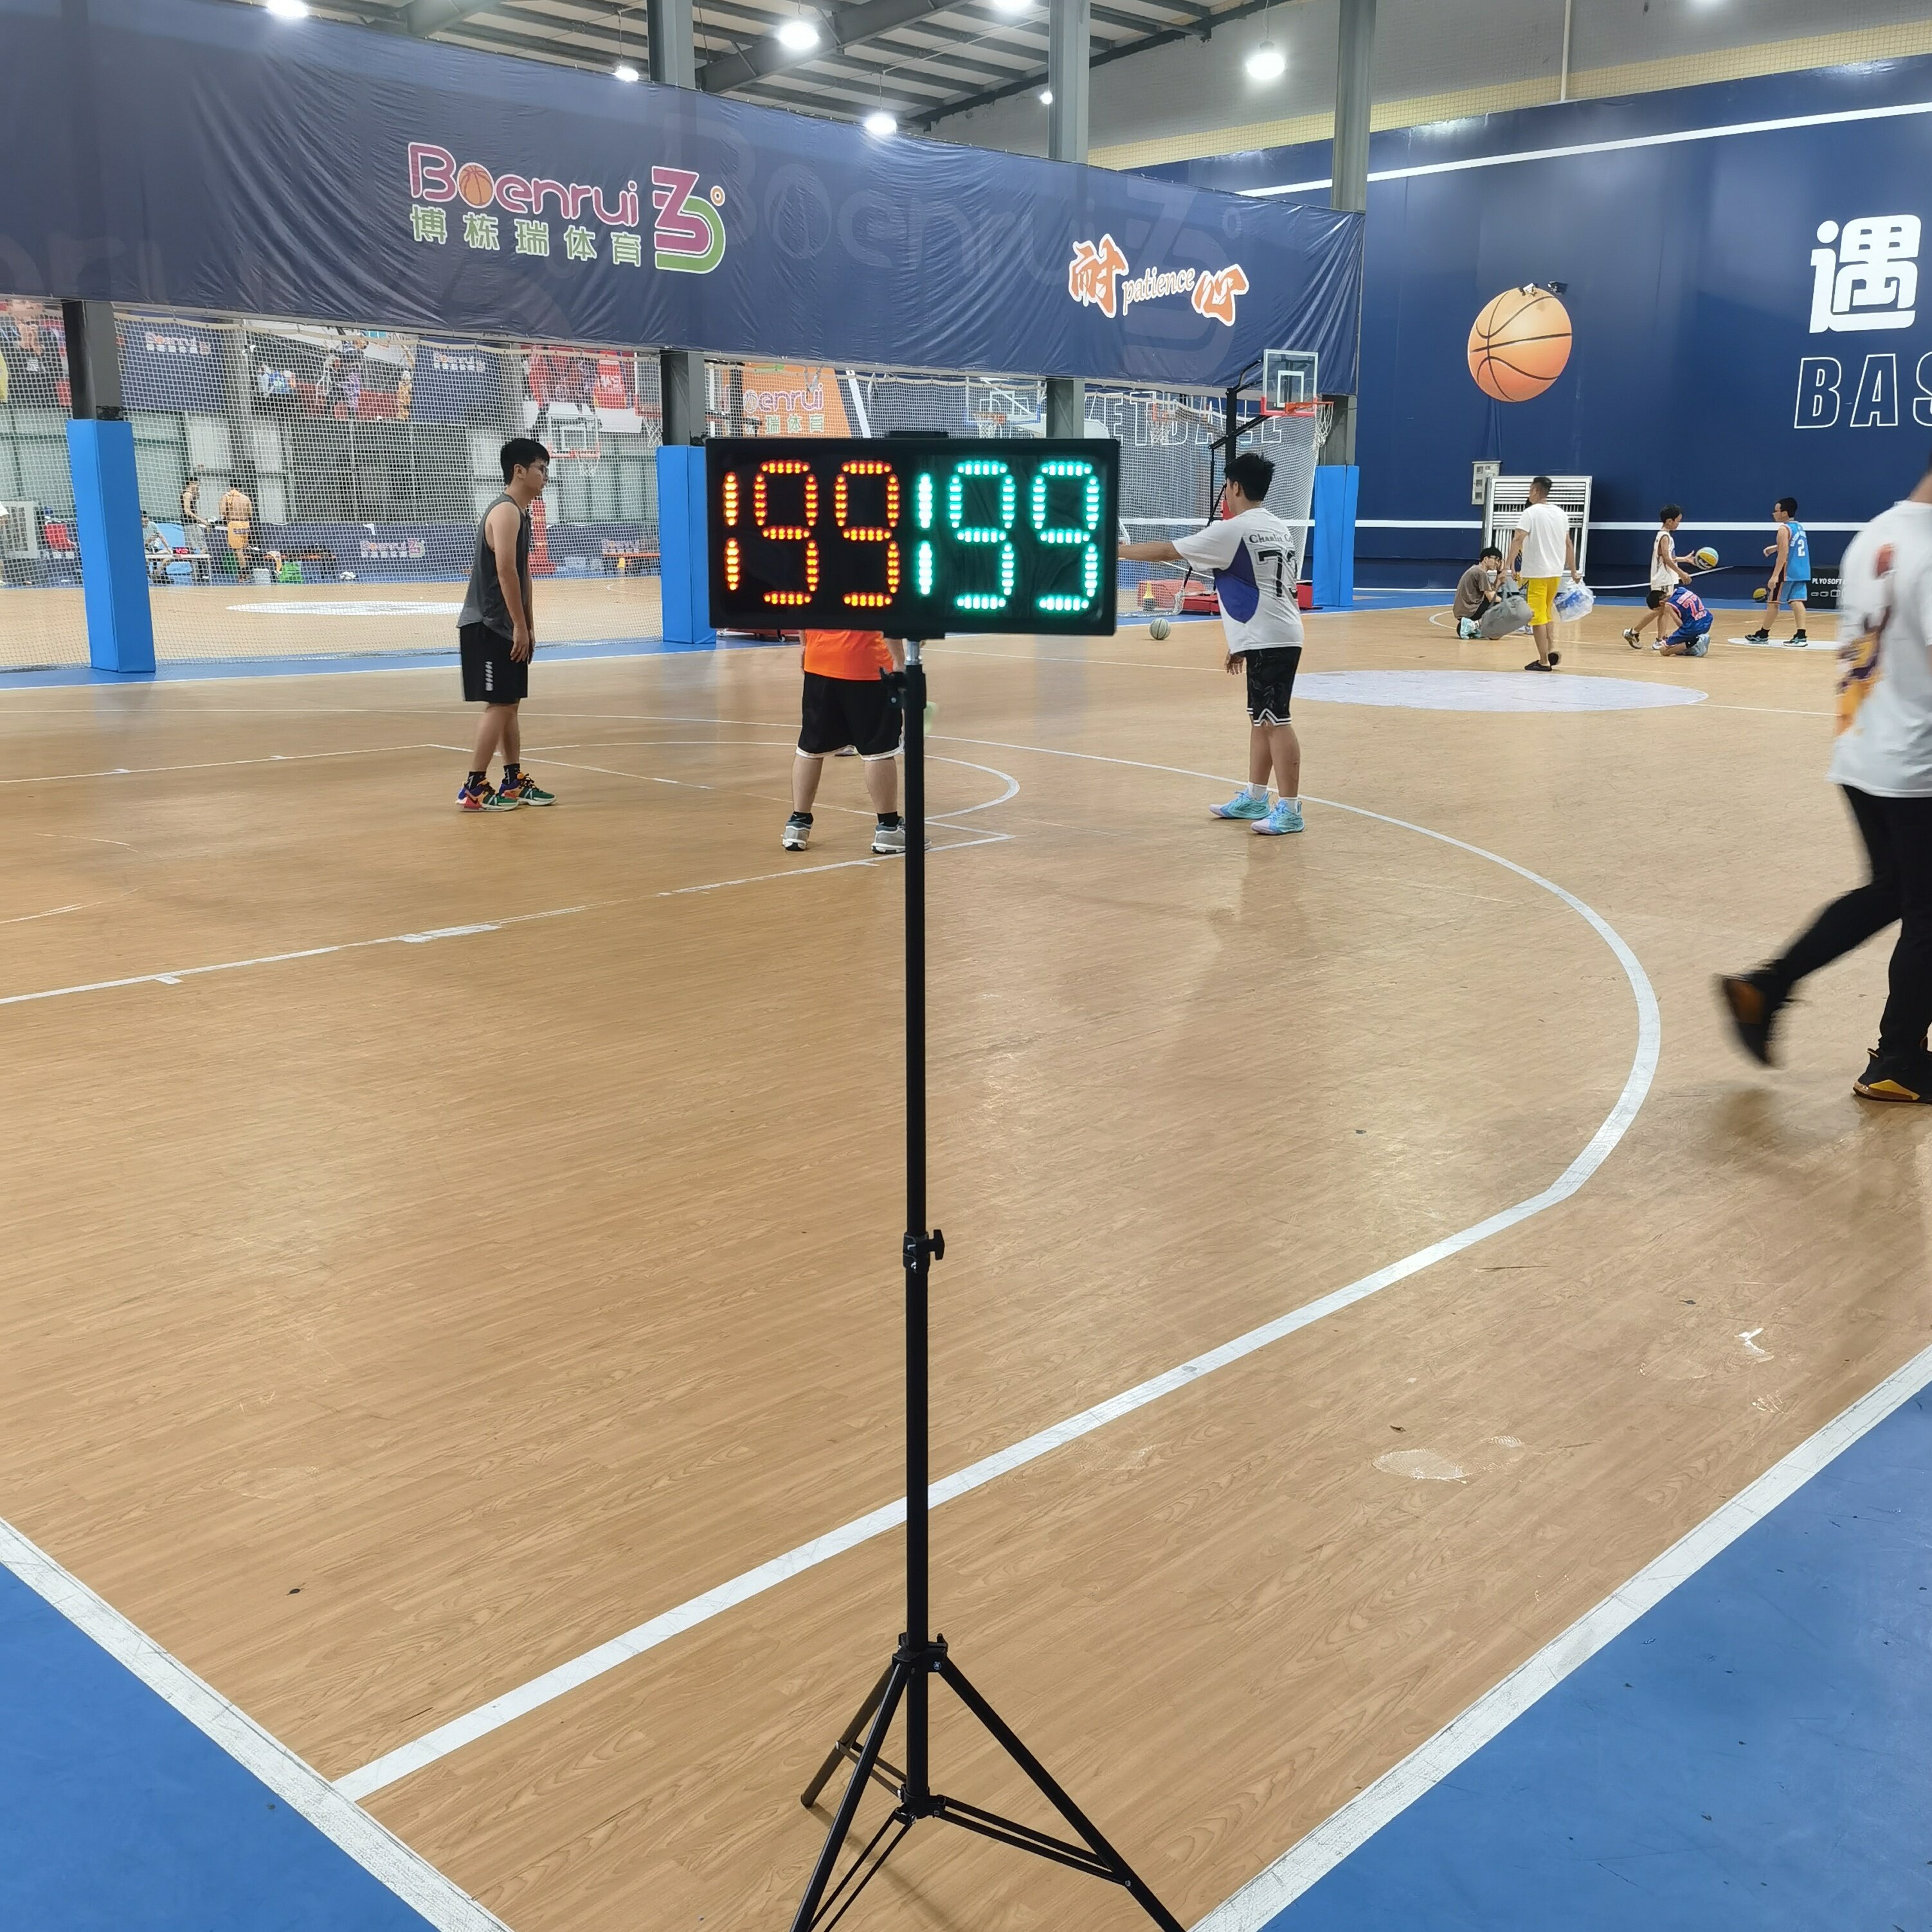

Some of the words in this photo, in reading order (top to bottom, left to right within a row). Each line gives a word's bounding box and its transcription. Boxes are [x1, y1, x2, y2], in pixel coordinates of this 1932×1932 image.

[410, 204, 642, 267] 博栋瑞体育
[1122, 266, 1196, 316] patience
[1809, 214, 1922, 333] 遇
[724, 459, 899, 607] 199
[918, 459, 1101, 610] 199
[1798, 539, 1806, 557] 2
